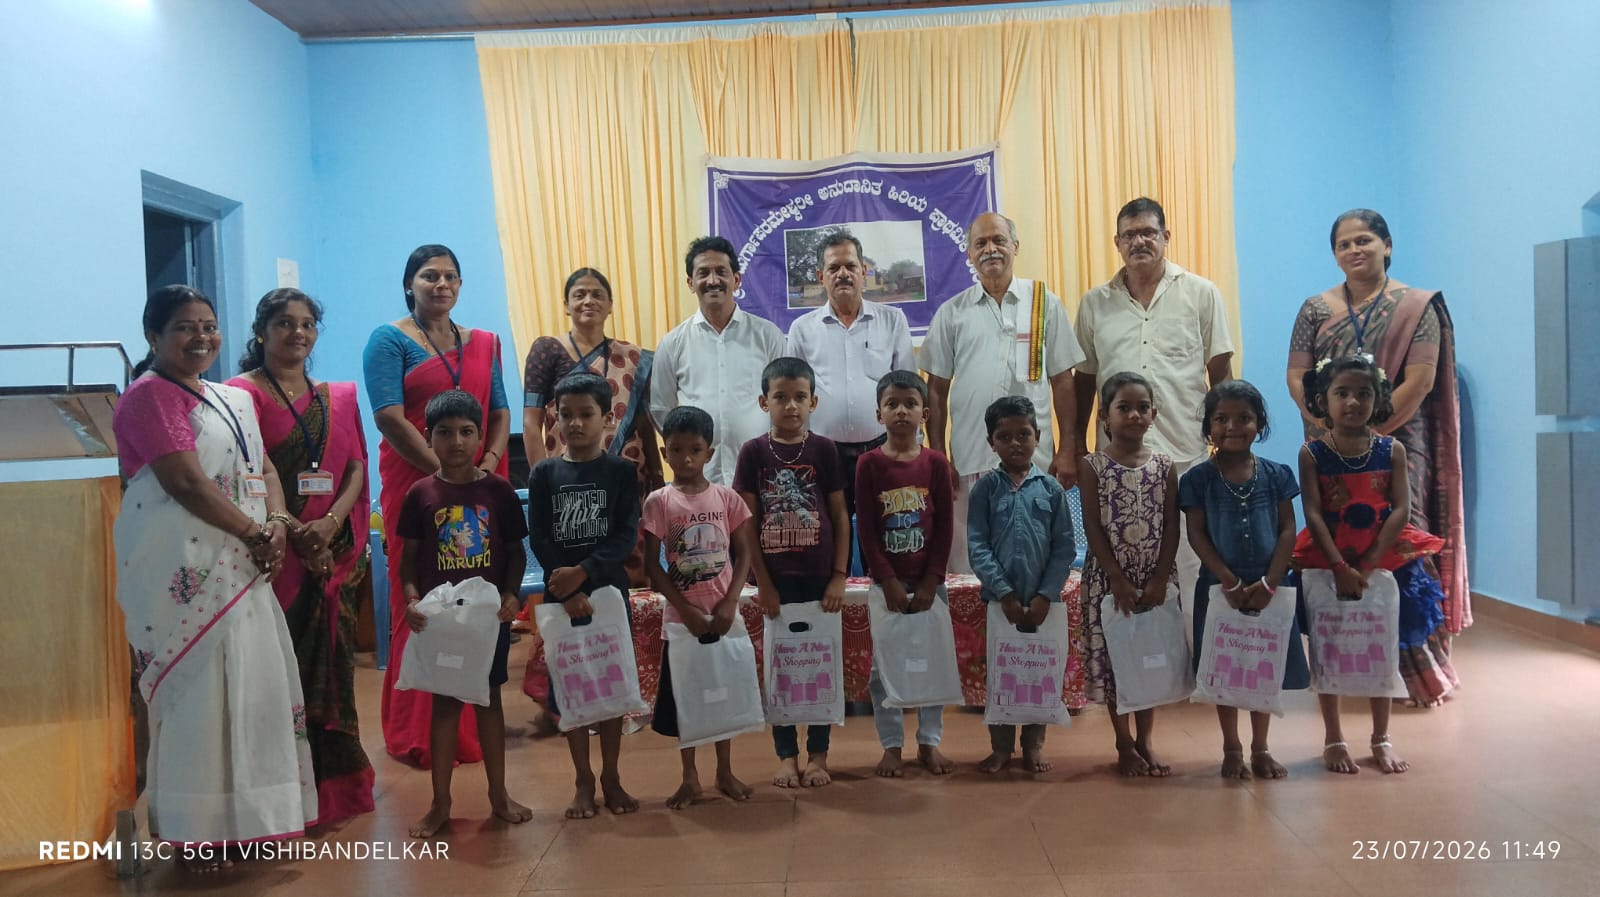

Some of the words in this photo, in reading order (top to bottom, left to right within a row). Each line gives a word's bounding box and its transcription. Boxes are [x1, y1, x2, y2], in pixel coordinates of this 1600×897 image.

[817, 179, 883, 200] ಅನುದಾನಿತ
[888, 186, 927, 212] ಹಿರಿಯ
[552, 490, 606, 513] LIMITED
[881, 487, 926, 512] BORN
[553, 517, 608, 541] EDITION
[894, 512, 911, 528] TO
[885, 529, 924, 553] LEAD
[437, 549, 490, 571] NARUTO
[1227, 638, 1265, 654] Shopping
[783, 656, 821, 668] Shopping
[1009, 656, 1047, 670] Shopping
